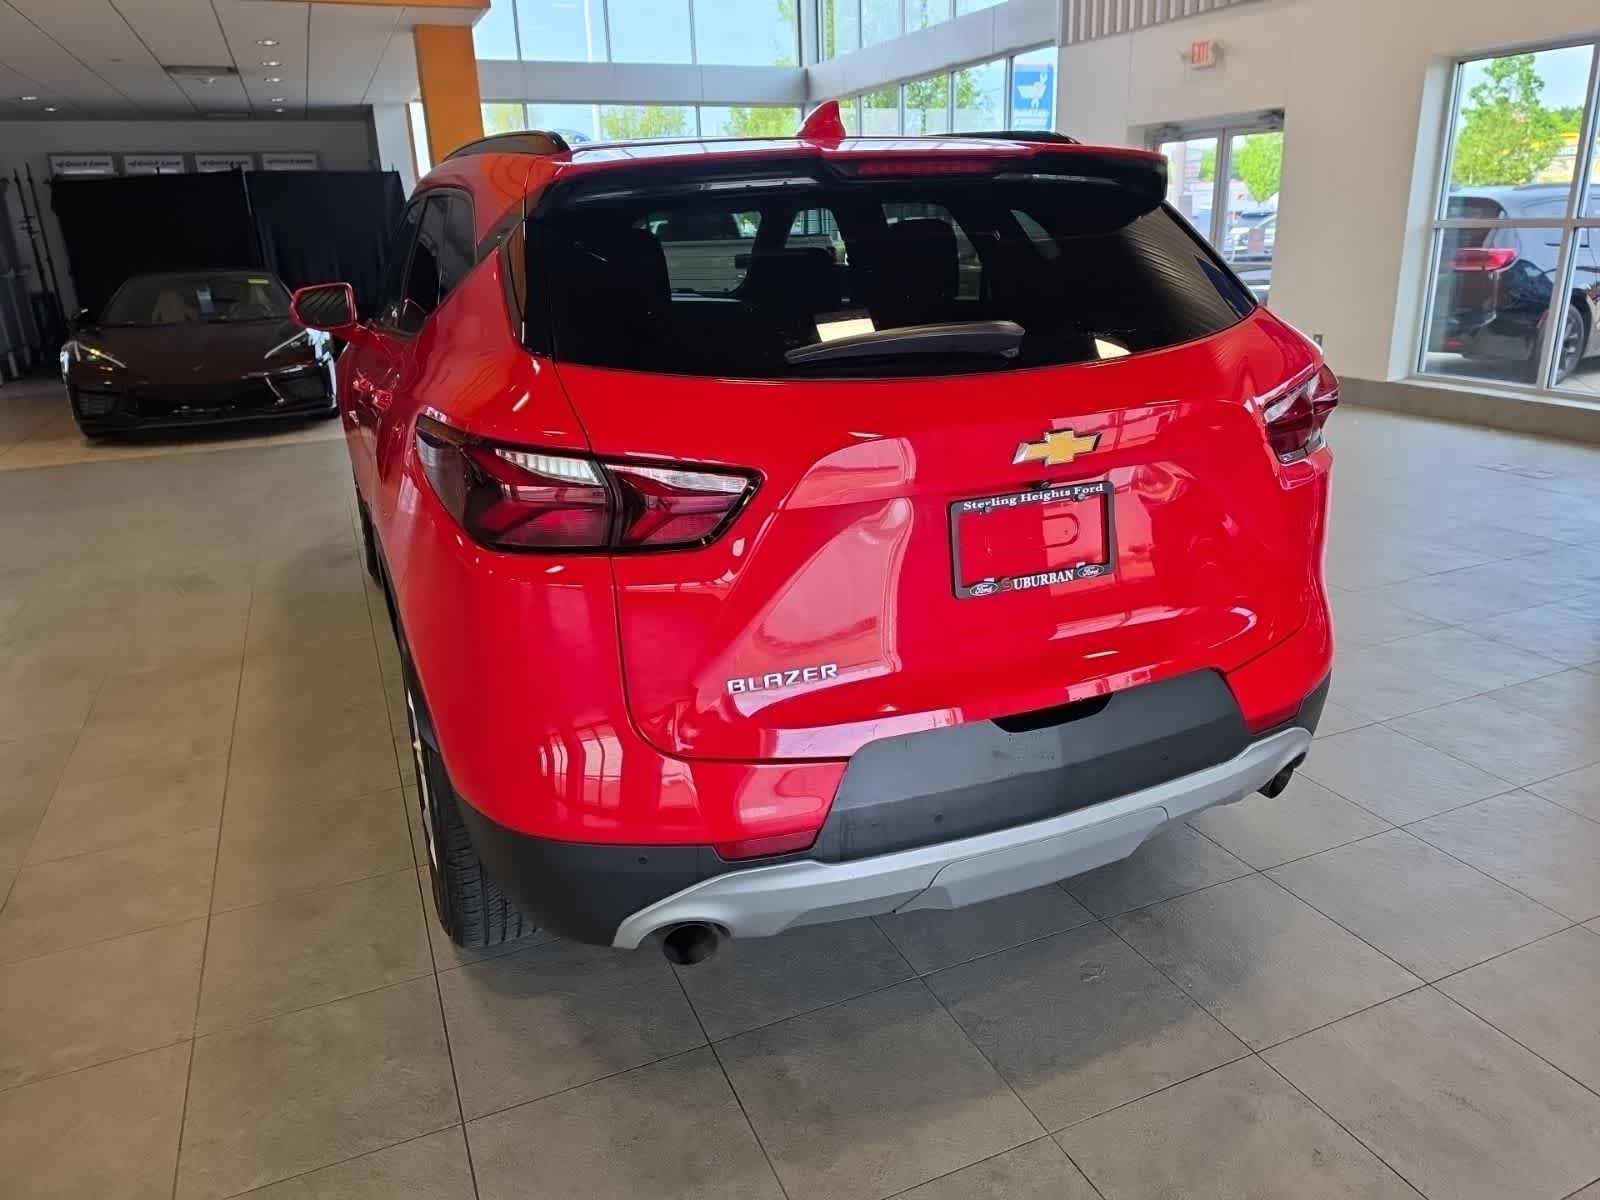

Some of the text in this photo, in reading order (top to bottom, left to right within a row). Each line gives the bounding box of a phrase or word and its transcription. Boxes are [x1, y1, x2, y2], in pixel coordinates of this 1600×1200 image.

[963, 483, 1104, 511] Sterling Heights Ford
[1001, 569, 1075, 592] SUBURBAN
[727, 663, 838, 695] BLAZER
